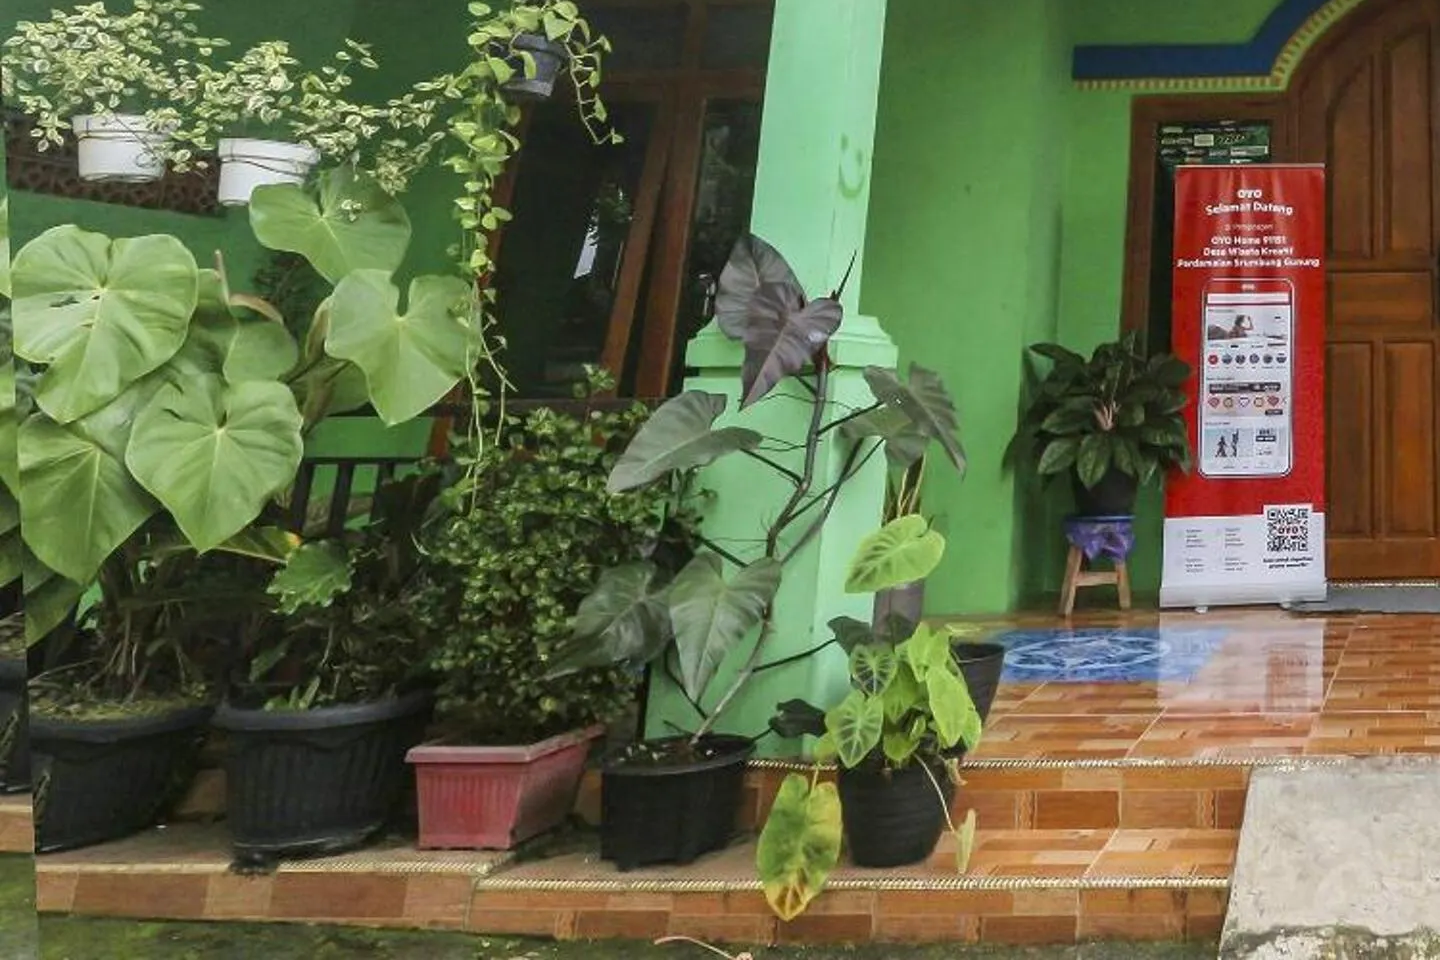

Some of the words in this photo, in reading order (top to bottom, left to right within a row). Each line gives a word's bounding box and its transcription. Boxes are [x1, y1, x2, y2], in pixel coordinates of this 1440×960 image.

[1237, 189, 1262, 198] OYO
[1205, 202, 1252, 215] Selamat
[1253, 202, 1293, 215] Datang
[1211, 236, 1232, 245] OYO
[1284, 257, 1320, 268] Gunung
[1277, 526, 1299, 535] OYO
